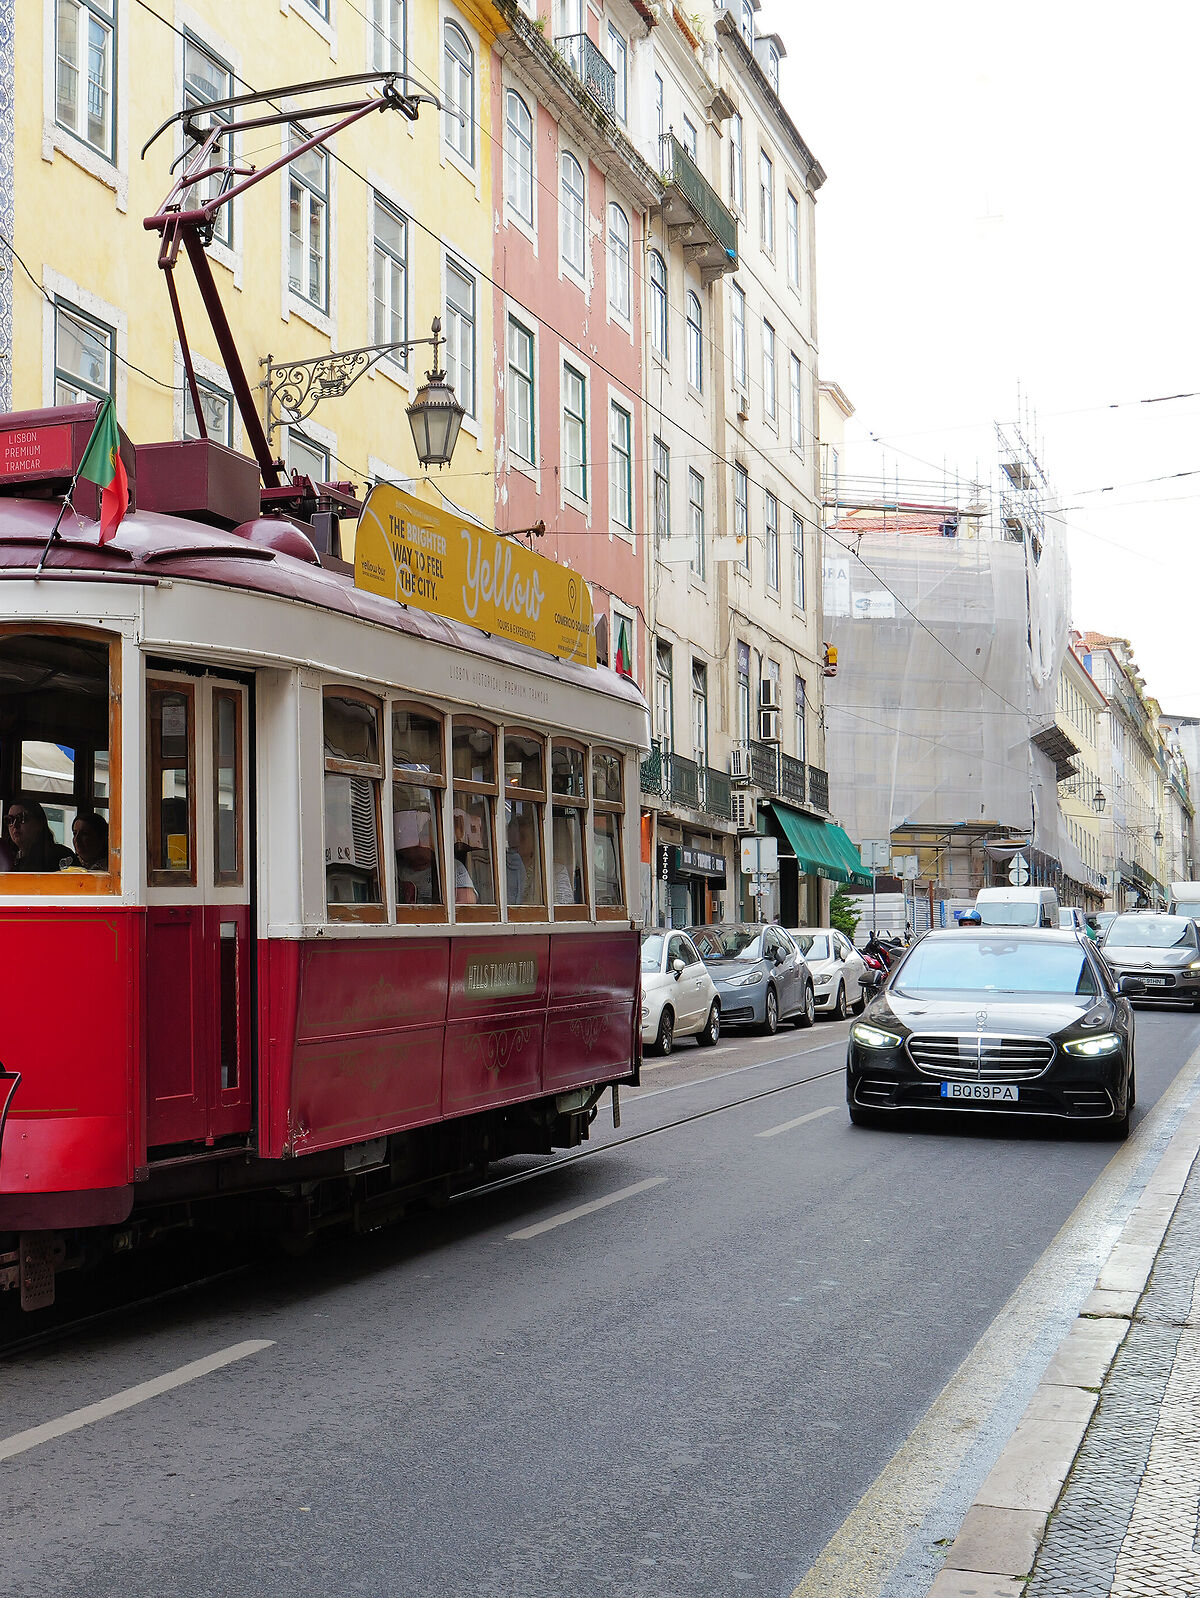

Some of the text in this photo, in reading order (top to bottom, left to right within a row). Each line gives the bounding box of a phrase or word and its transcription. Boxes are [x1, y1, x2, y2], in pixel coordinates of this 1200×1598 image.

[8, 431, 37, 445] LISBON
[5, 445, 41, 458] PREMIUM
[5, 458, 41, 472] TRAMCAR
[389, 514, 447, 556] THE BRIGHTER
[392, 541, 444, 579] WAY TO FEEL
[400, 569, 416, 593] THE
[417, 576, 438, 602] CITY.
[497, 618, 510, 632] TOURS
[513, 625, 536, 642] EXPERIENCES
[449, 664, 470, 682] LISBON
[468, 963, 488, 990] HILLS
[952, 1084, 1014, 1100] BQ69PA
